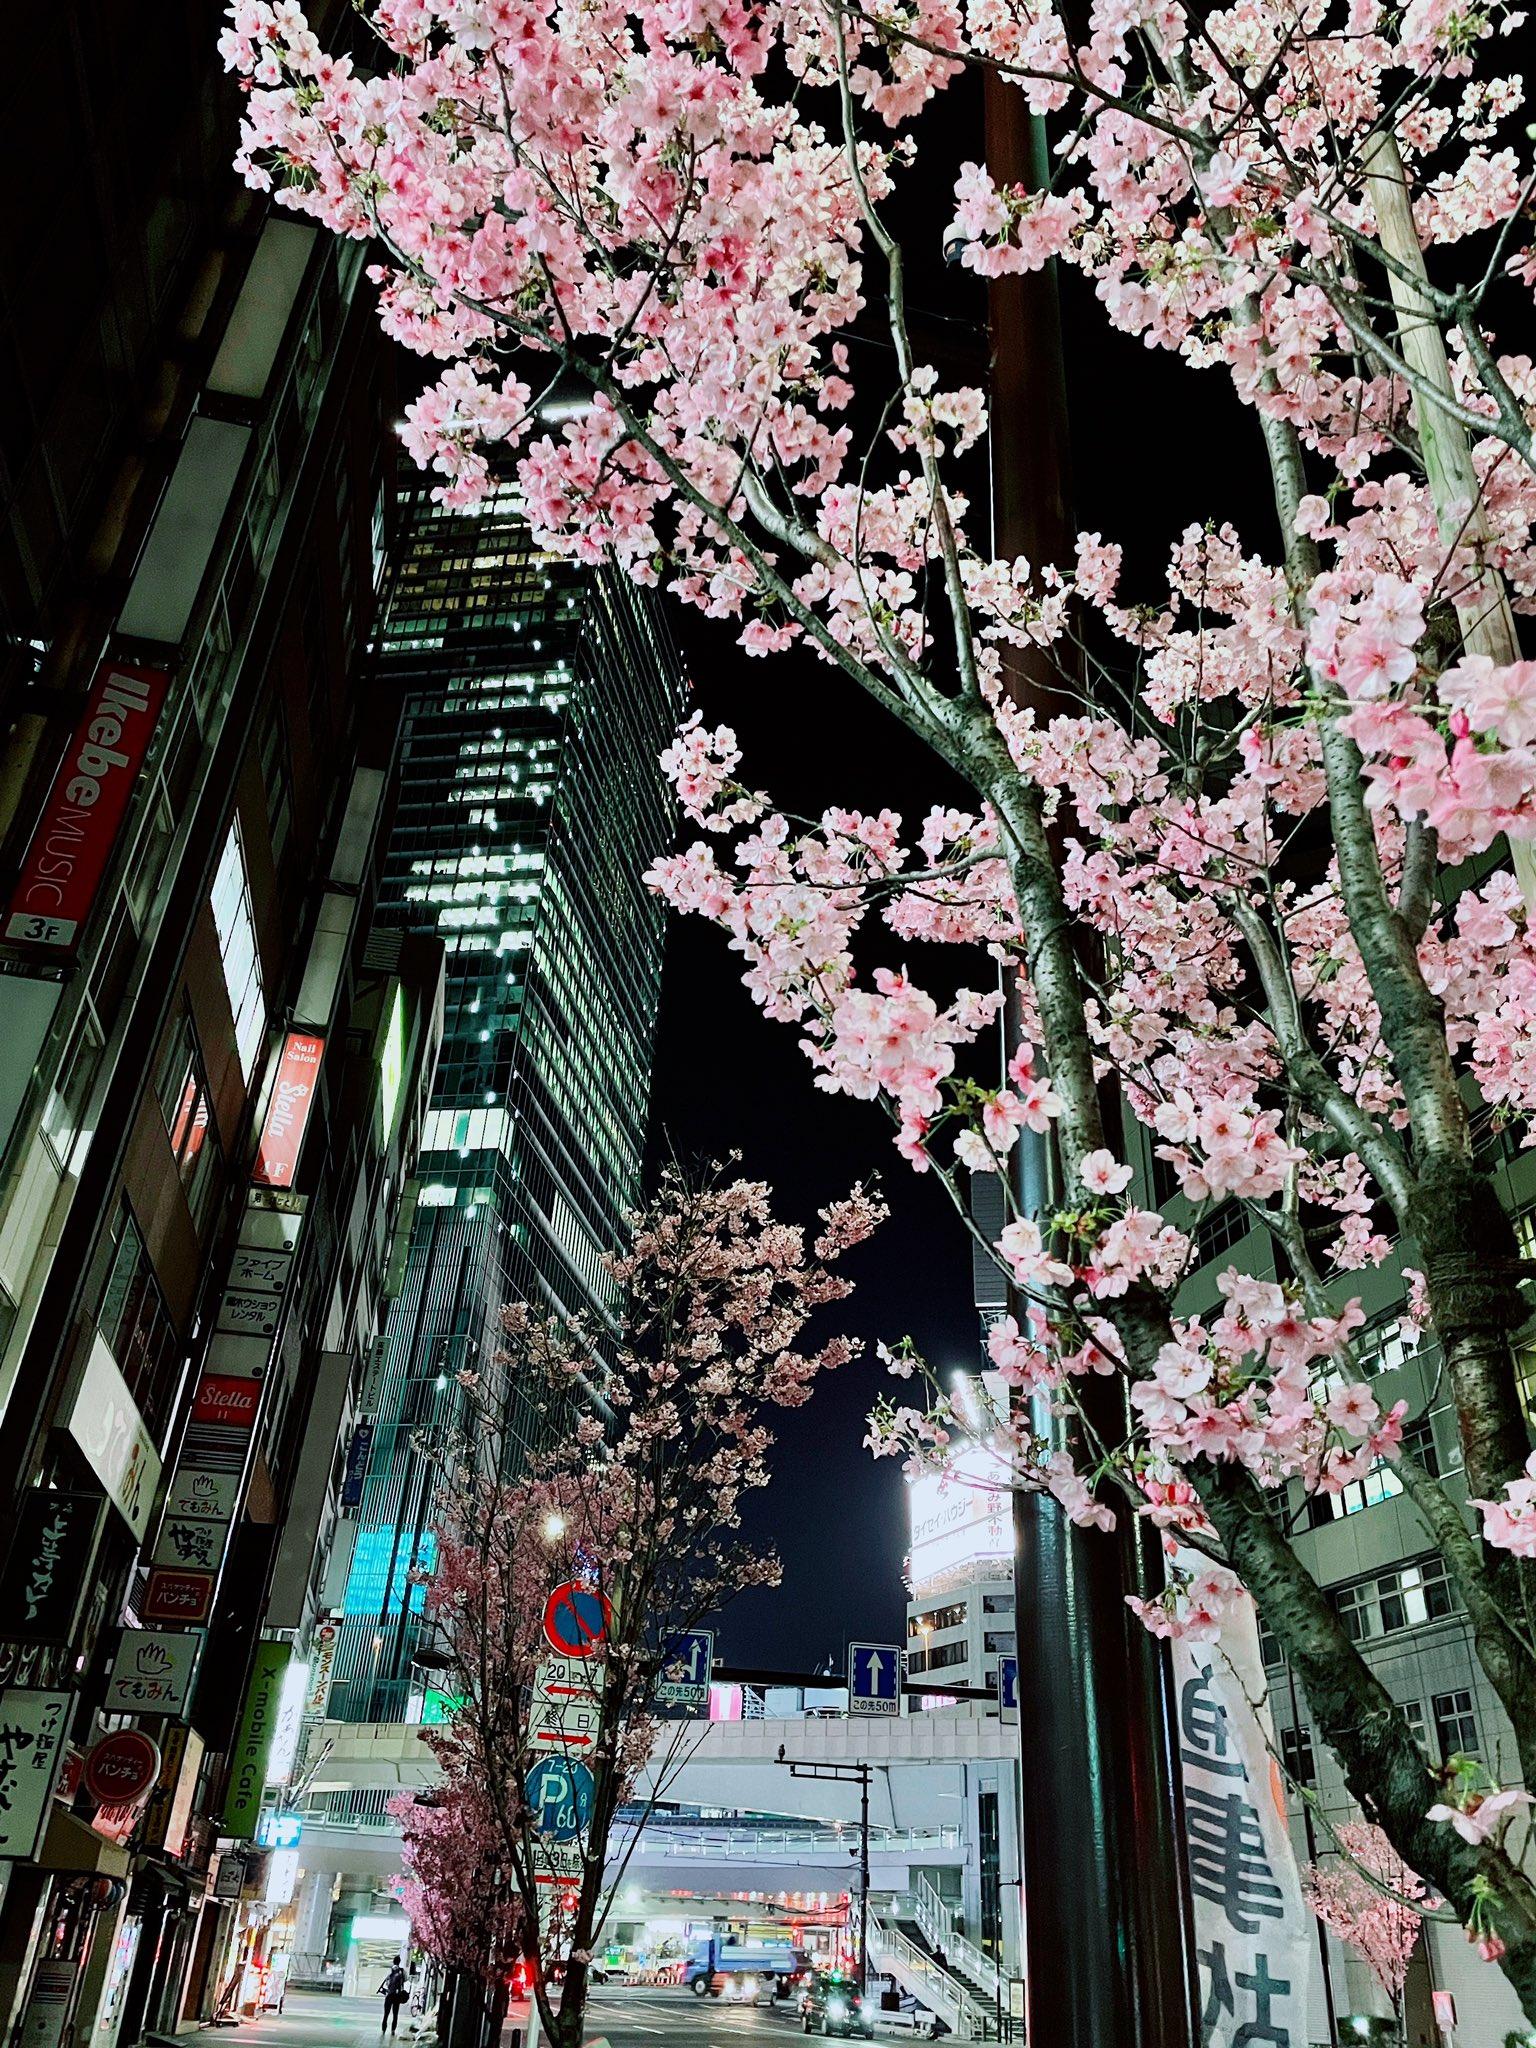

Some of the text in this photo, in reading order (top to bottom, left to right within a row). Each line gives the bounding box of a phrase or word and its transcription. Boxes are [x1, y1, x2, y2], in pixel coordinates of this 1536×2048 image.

[26, 672, 150, 907] Ikebe MUSIC
[24, 917, 59, 942] 3F
[293, 1041, 316, 1054] Nail
[286, 1050, 317, 1064] Salon
[268, 1080, 309, 1138] Stella
[240, 1268, 275, 1281] ホーム
[231, 1310, 266, 1322] レンタル
[201, 1383, 253, 1409] Stella
[178, 1500, 224, 1516] てもみん
[156, 1591, 198, 1606] パンチョ
[115, 1680, 180, 1702] てもみん
[246, 1666, 276, 1756] X-mobile
[852, 1700, 897, 1713] この先50m
[98, 1763, 139, 1781] パンチョ
[548, 1759, 578, 1774] 7-20
[539, 1773, 568, 1825] P
